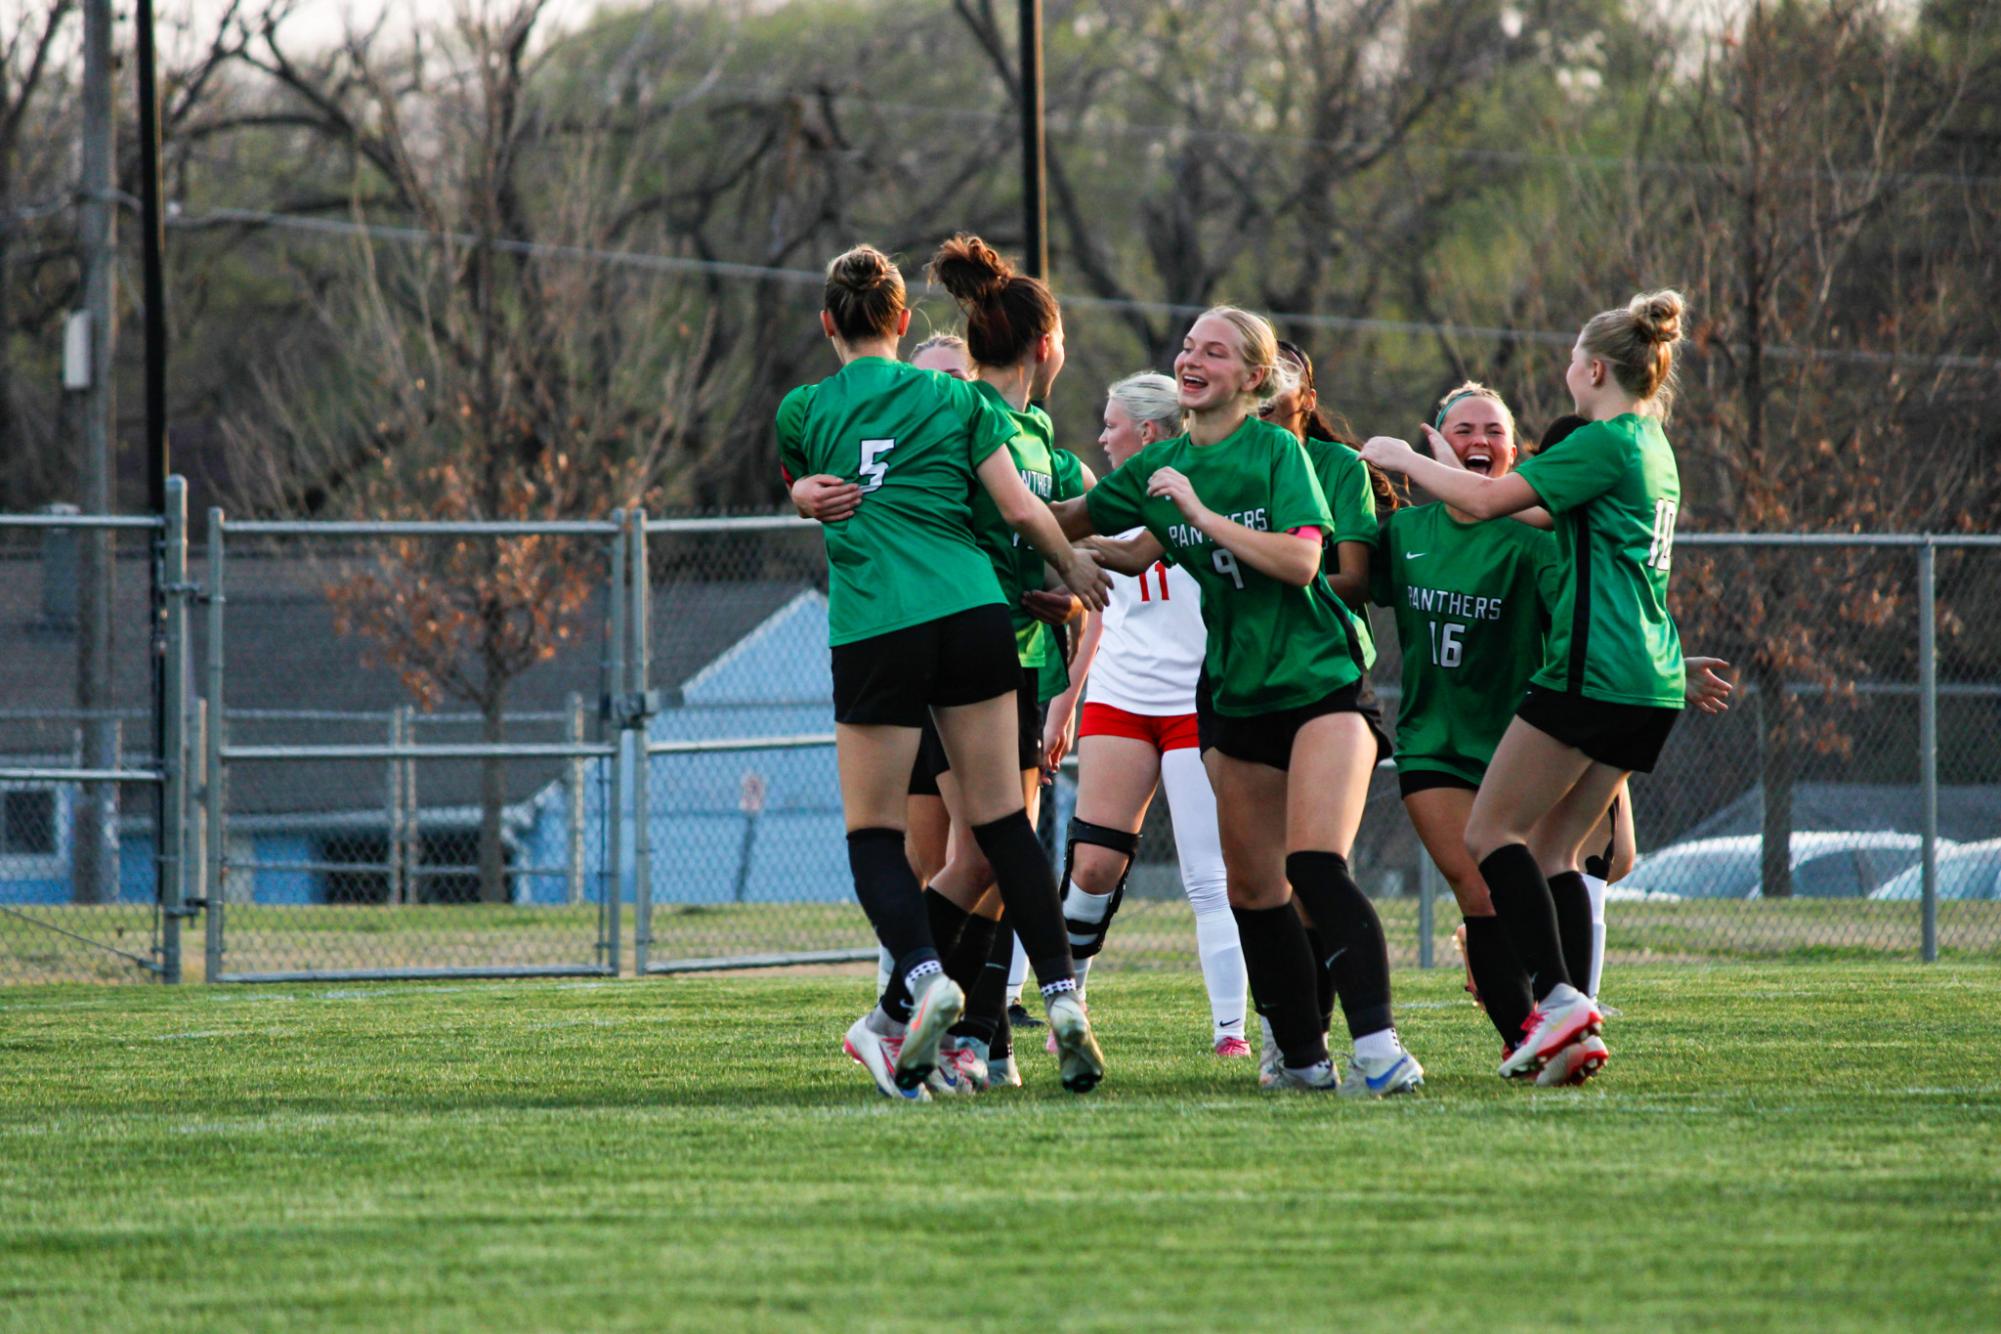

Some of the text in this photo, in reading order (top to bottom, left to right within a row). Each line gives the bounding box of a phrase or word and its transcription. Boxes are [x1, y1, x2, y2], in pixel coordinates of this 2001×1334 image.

[859, 438, 895, 493] 5
[1168, 508, 1269, 548] PANRS
[1139, 561, 1170, 602] 11
[1212, 548, 1244, 589] 9
[1407, 585, 1502, 620] PANTHERS
[1429, 621, 1466, 668] 16
